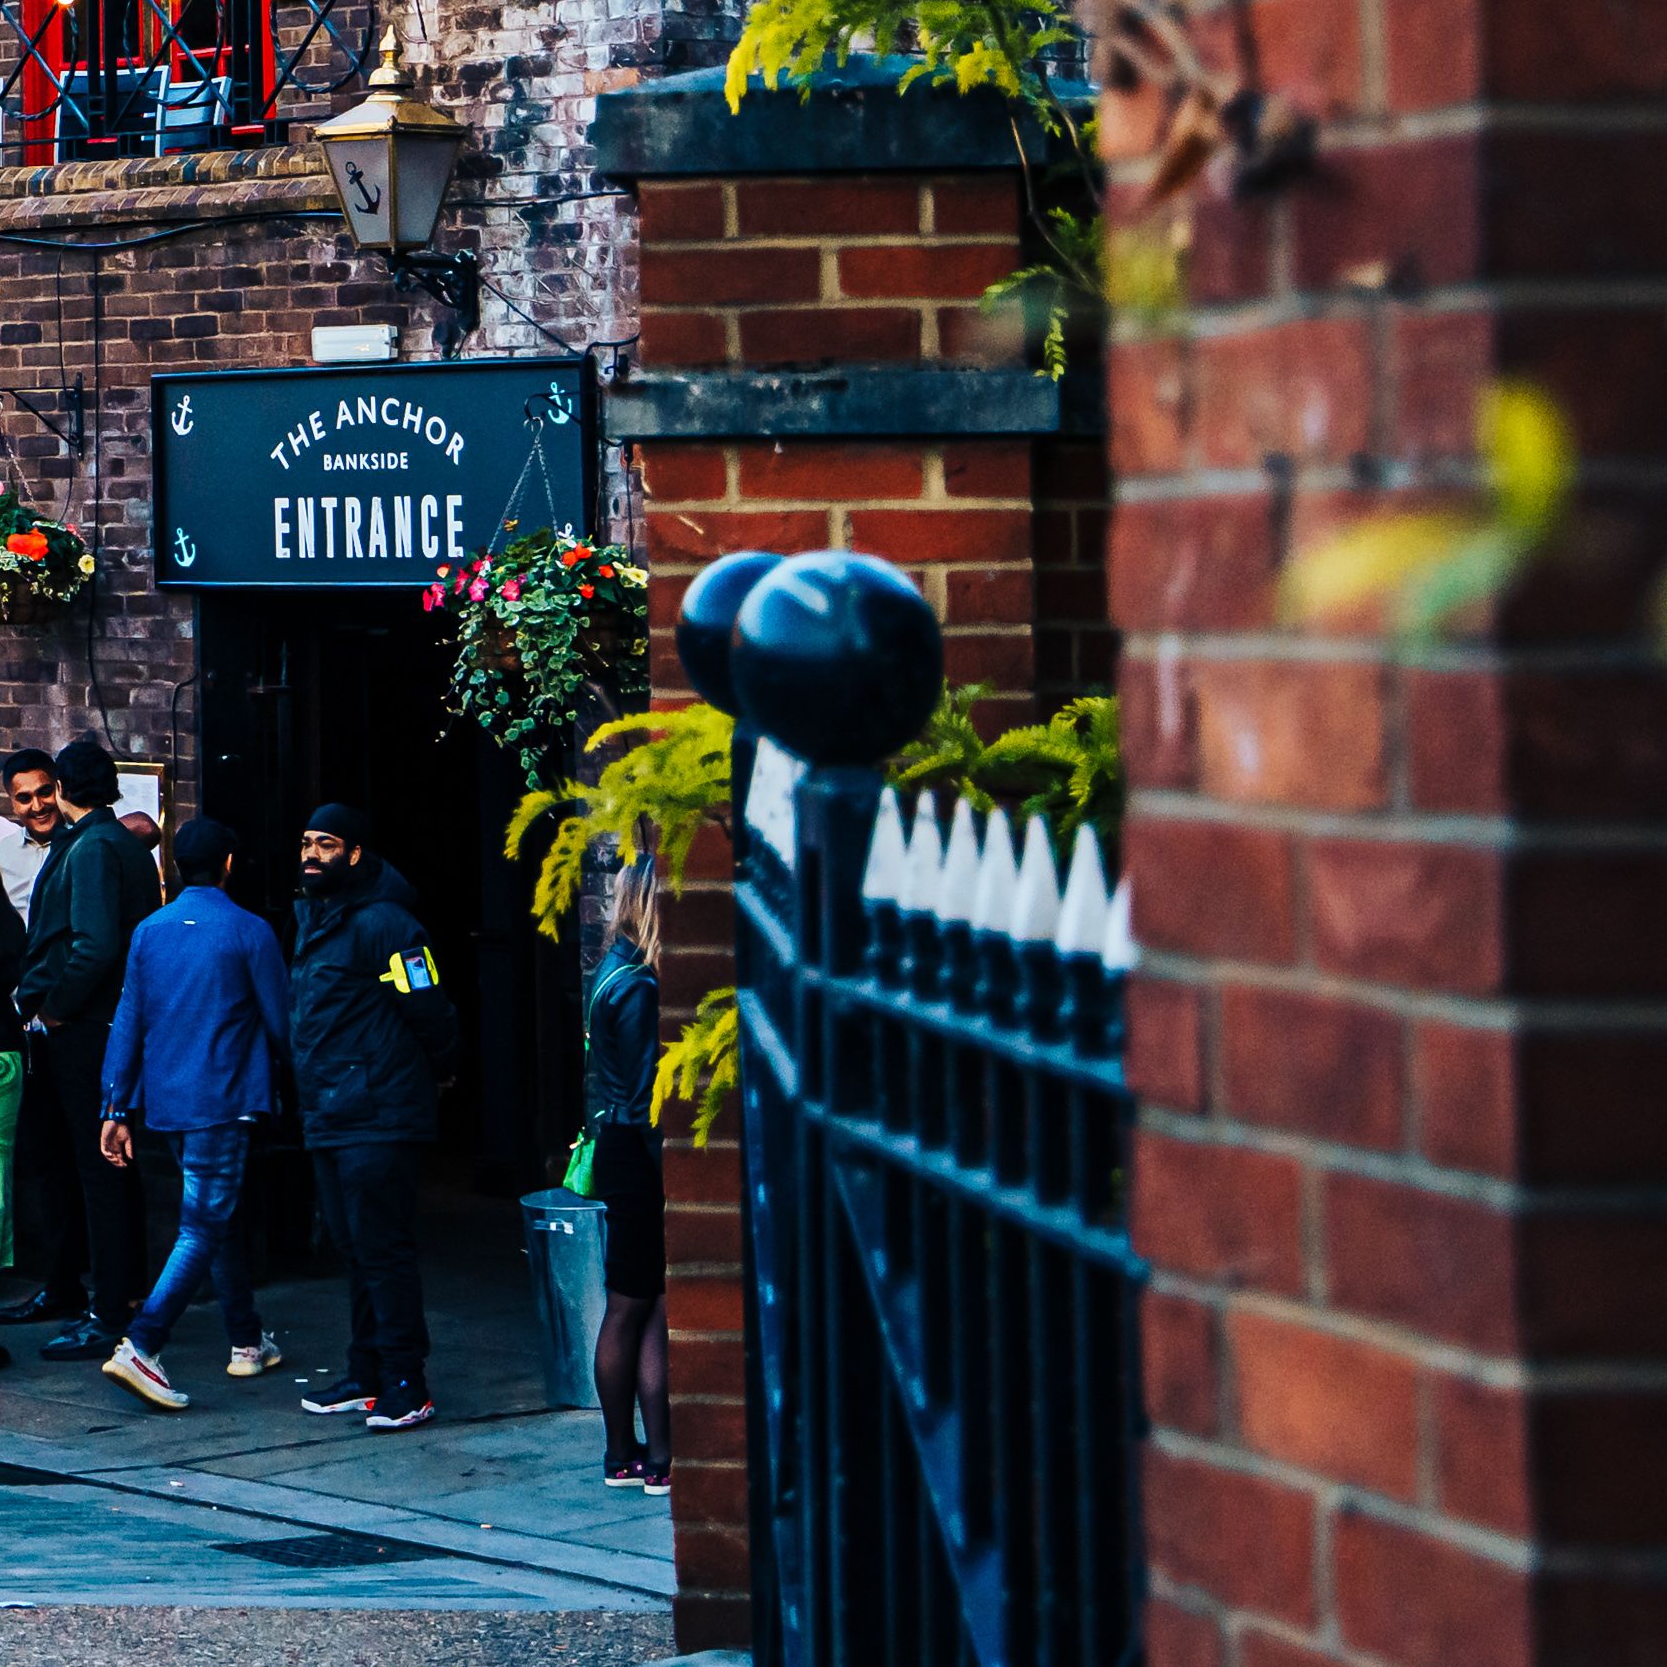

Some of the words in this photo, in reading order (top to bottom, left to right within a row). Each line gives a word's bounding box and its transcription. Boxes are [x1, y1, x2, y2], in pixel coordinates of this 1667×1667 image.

[270, 410, 327, 470] THE
[336, 396, 465, 465] ANCHOR
[323, 451, 409, 471] BANKSIDE
[274, 494, 465, 559] ENTRANCE
